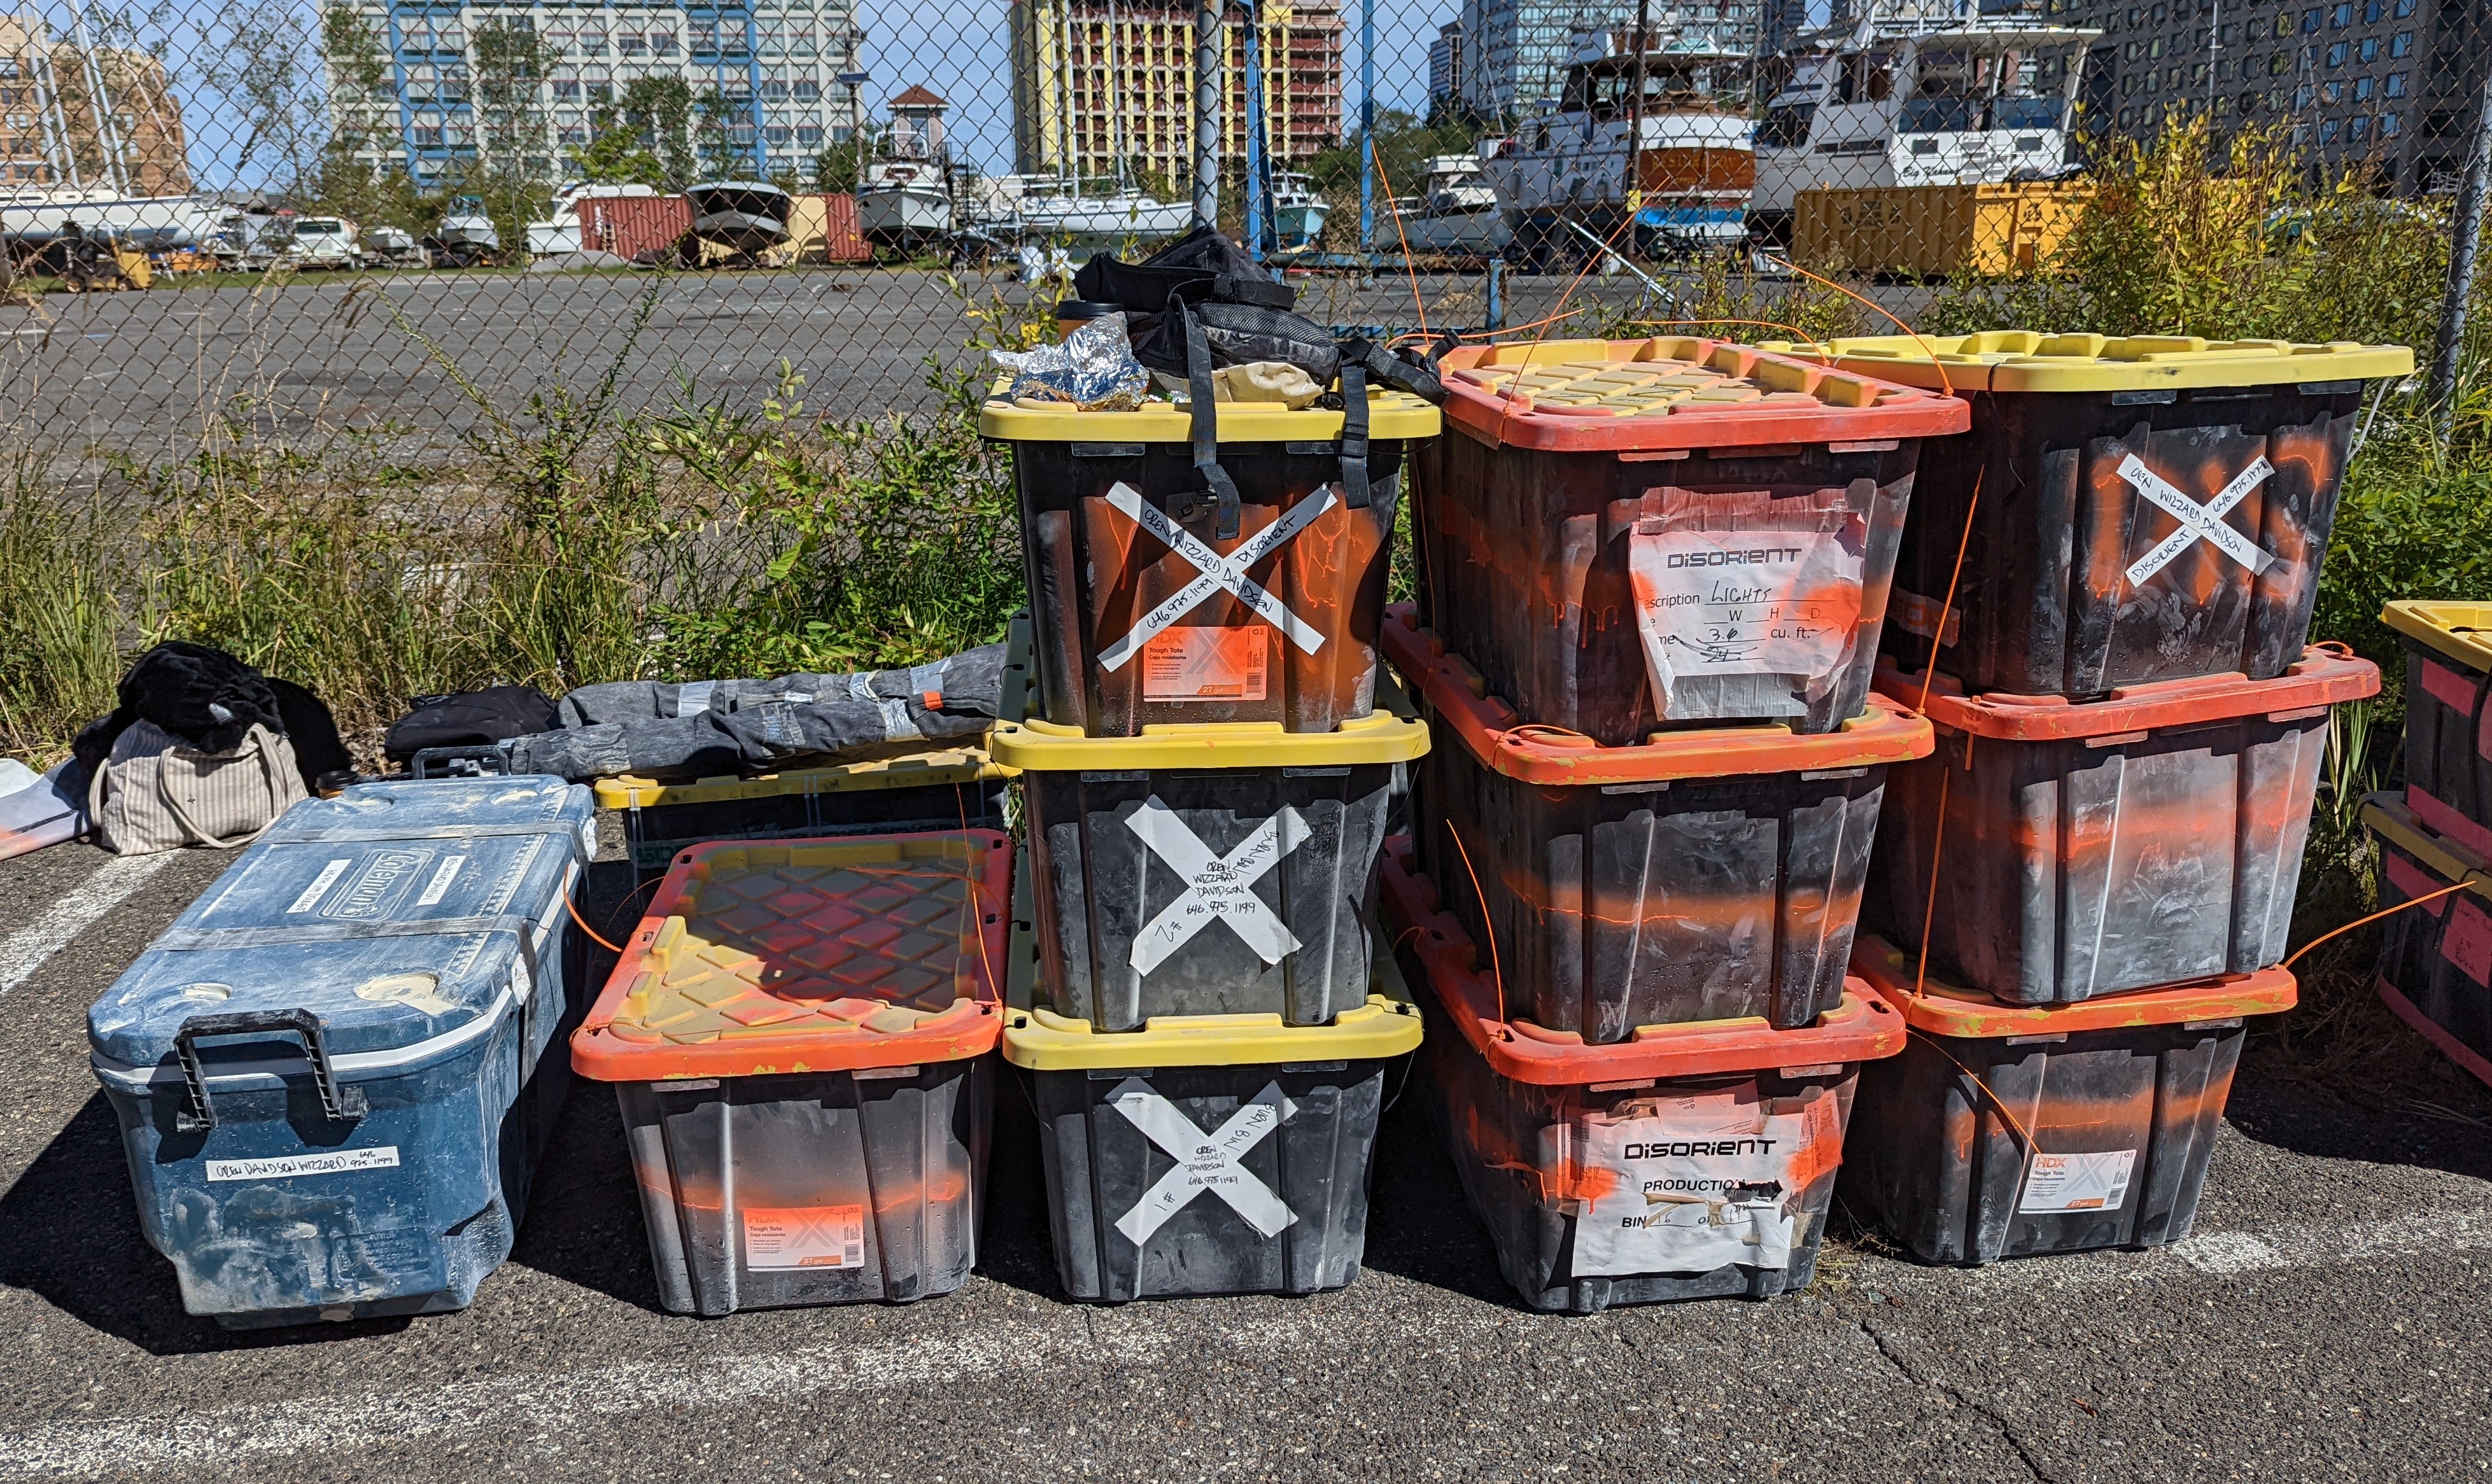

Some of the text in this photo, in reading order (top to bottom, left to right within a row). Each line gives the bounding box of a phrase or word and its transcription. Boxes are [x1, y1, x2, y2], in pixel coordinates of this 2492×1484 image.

[1711, 580, 1772, 603] LIGHTS
[1645, 593, 1700, 609] escription
[1729, 608, 1820, 622] W H D
[1771, 627, 1810, 639] cu. ft.
[349, 853, 423, 904] Coleman
[1820, 1103, 1834, 1133] DX
[298, 1156, 347, 1172] WIZZARD
[2036, 1158, 2067, 1168] HDX
[1644, 1179, 1745, 1193] PRODUCTIO
[1622, 1215, 1647, 1228] BIN
